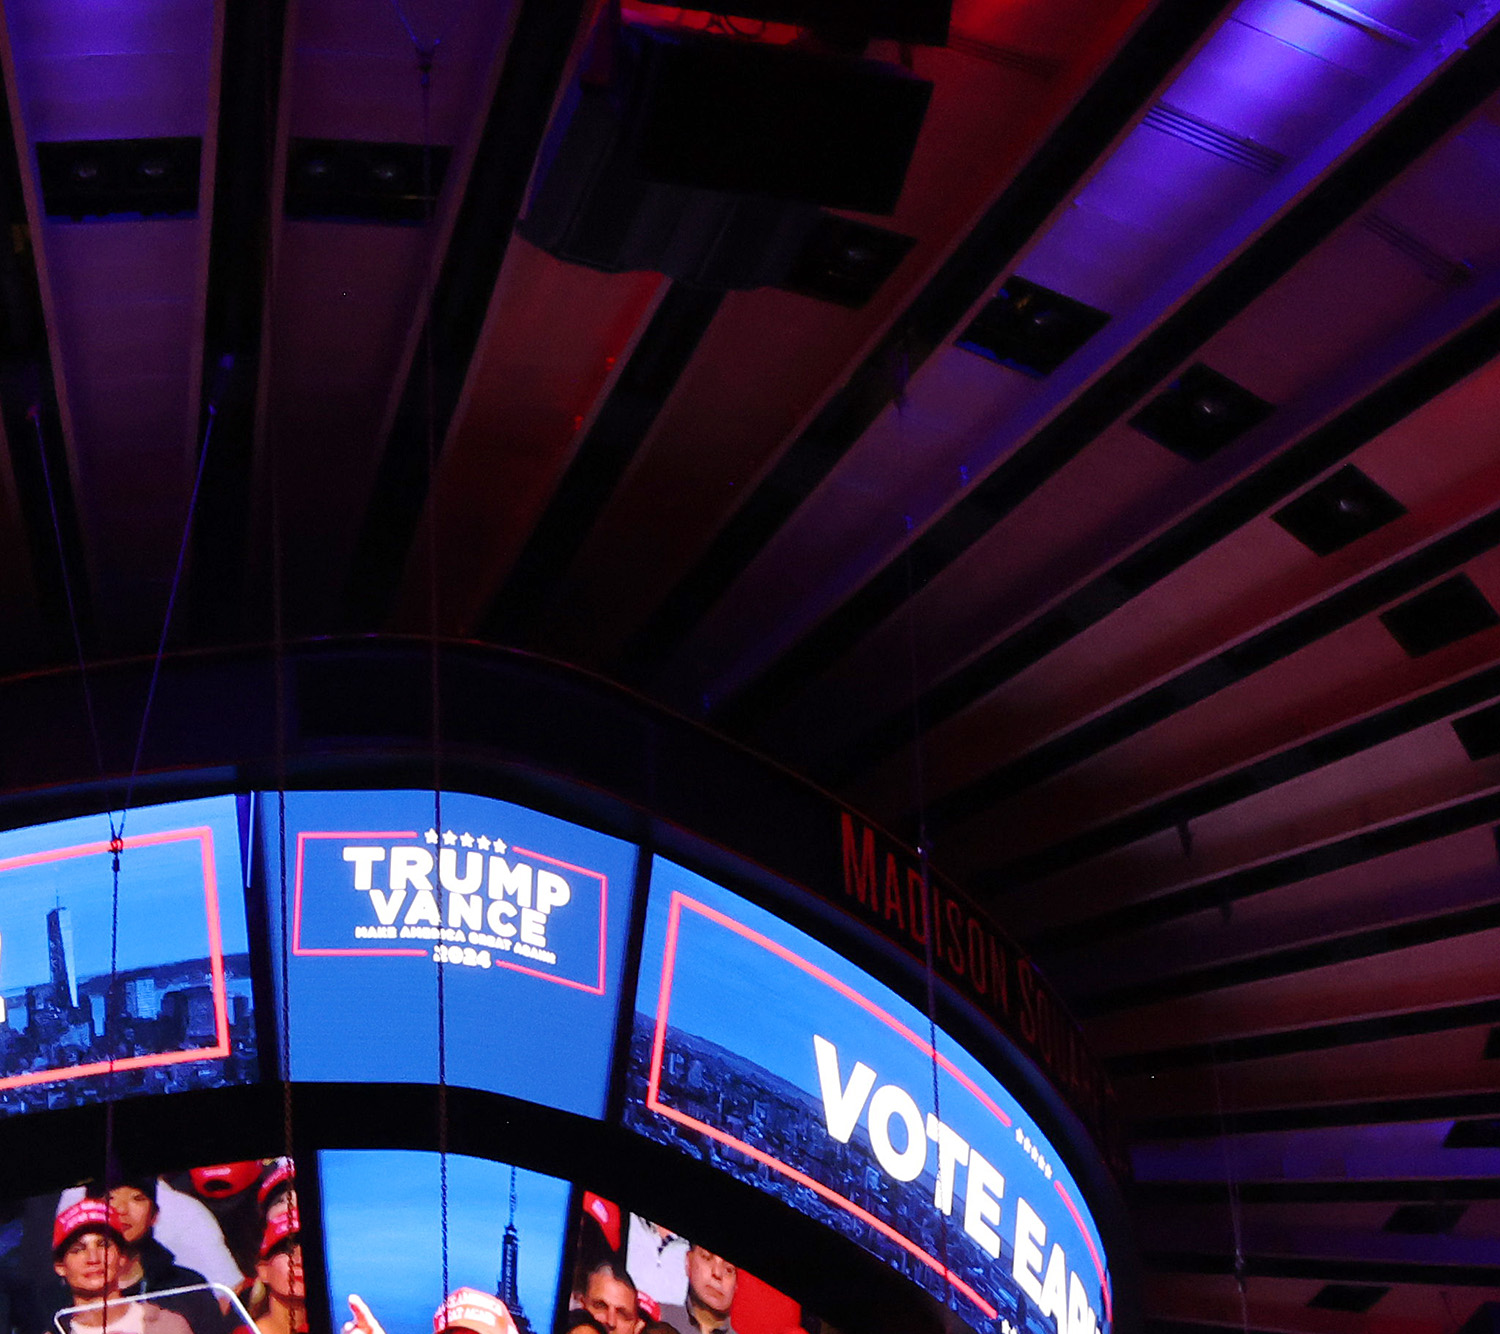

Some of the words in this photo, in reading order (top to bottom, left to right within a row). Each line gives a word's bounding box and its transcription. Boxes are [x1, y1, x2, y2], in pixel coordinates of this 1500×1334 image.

[342, 846, 571, 914] TRUMP
[354, 926, 398, 939] MAKE
[400, 926, 466, 943] AMERICA
[369, 889, 547, 948] VANCE
[840, 810, 1009, 1015] MADISON
[432, 944, 492, 969] 2024
[813, 1034, 1005, 1260] VOTE
